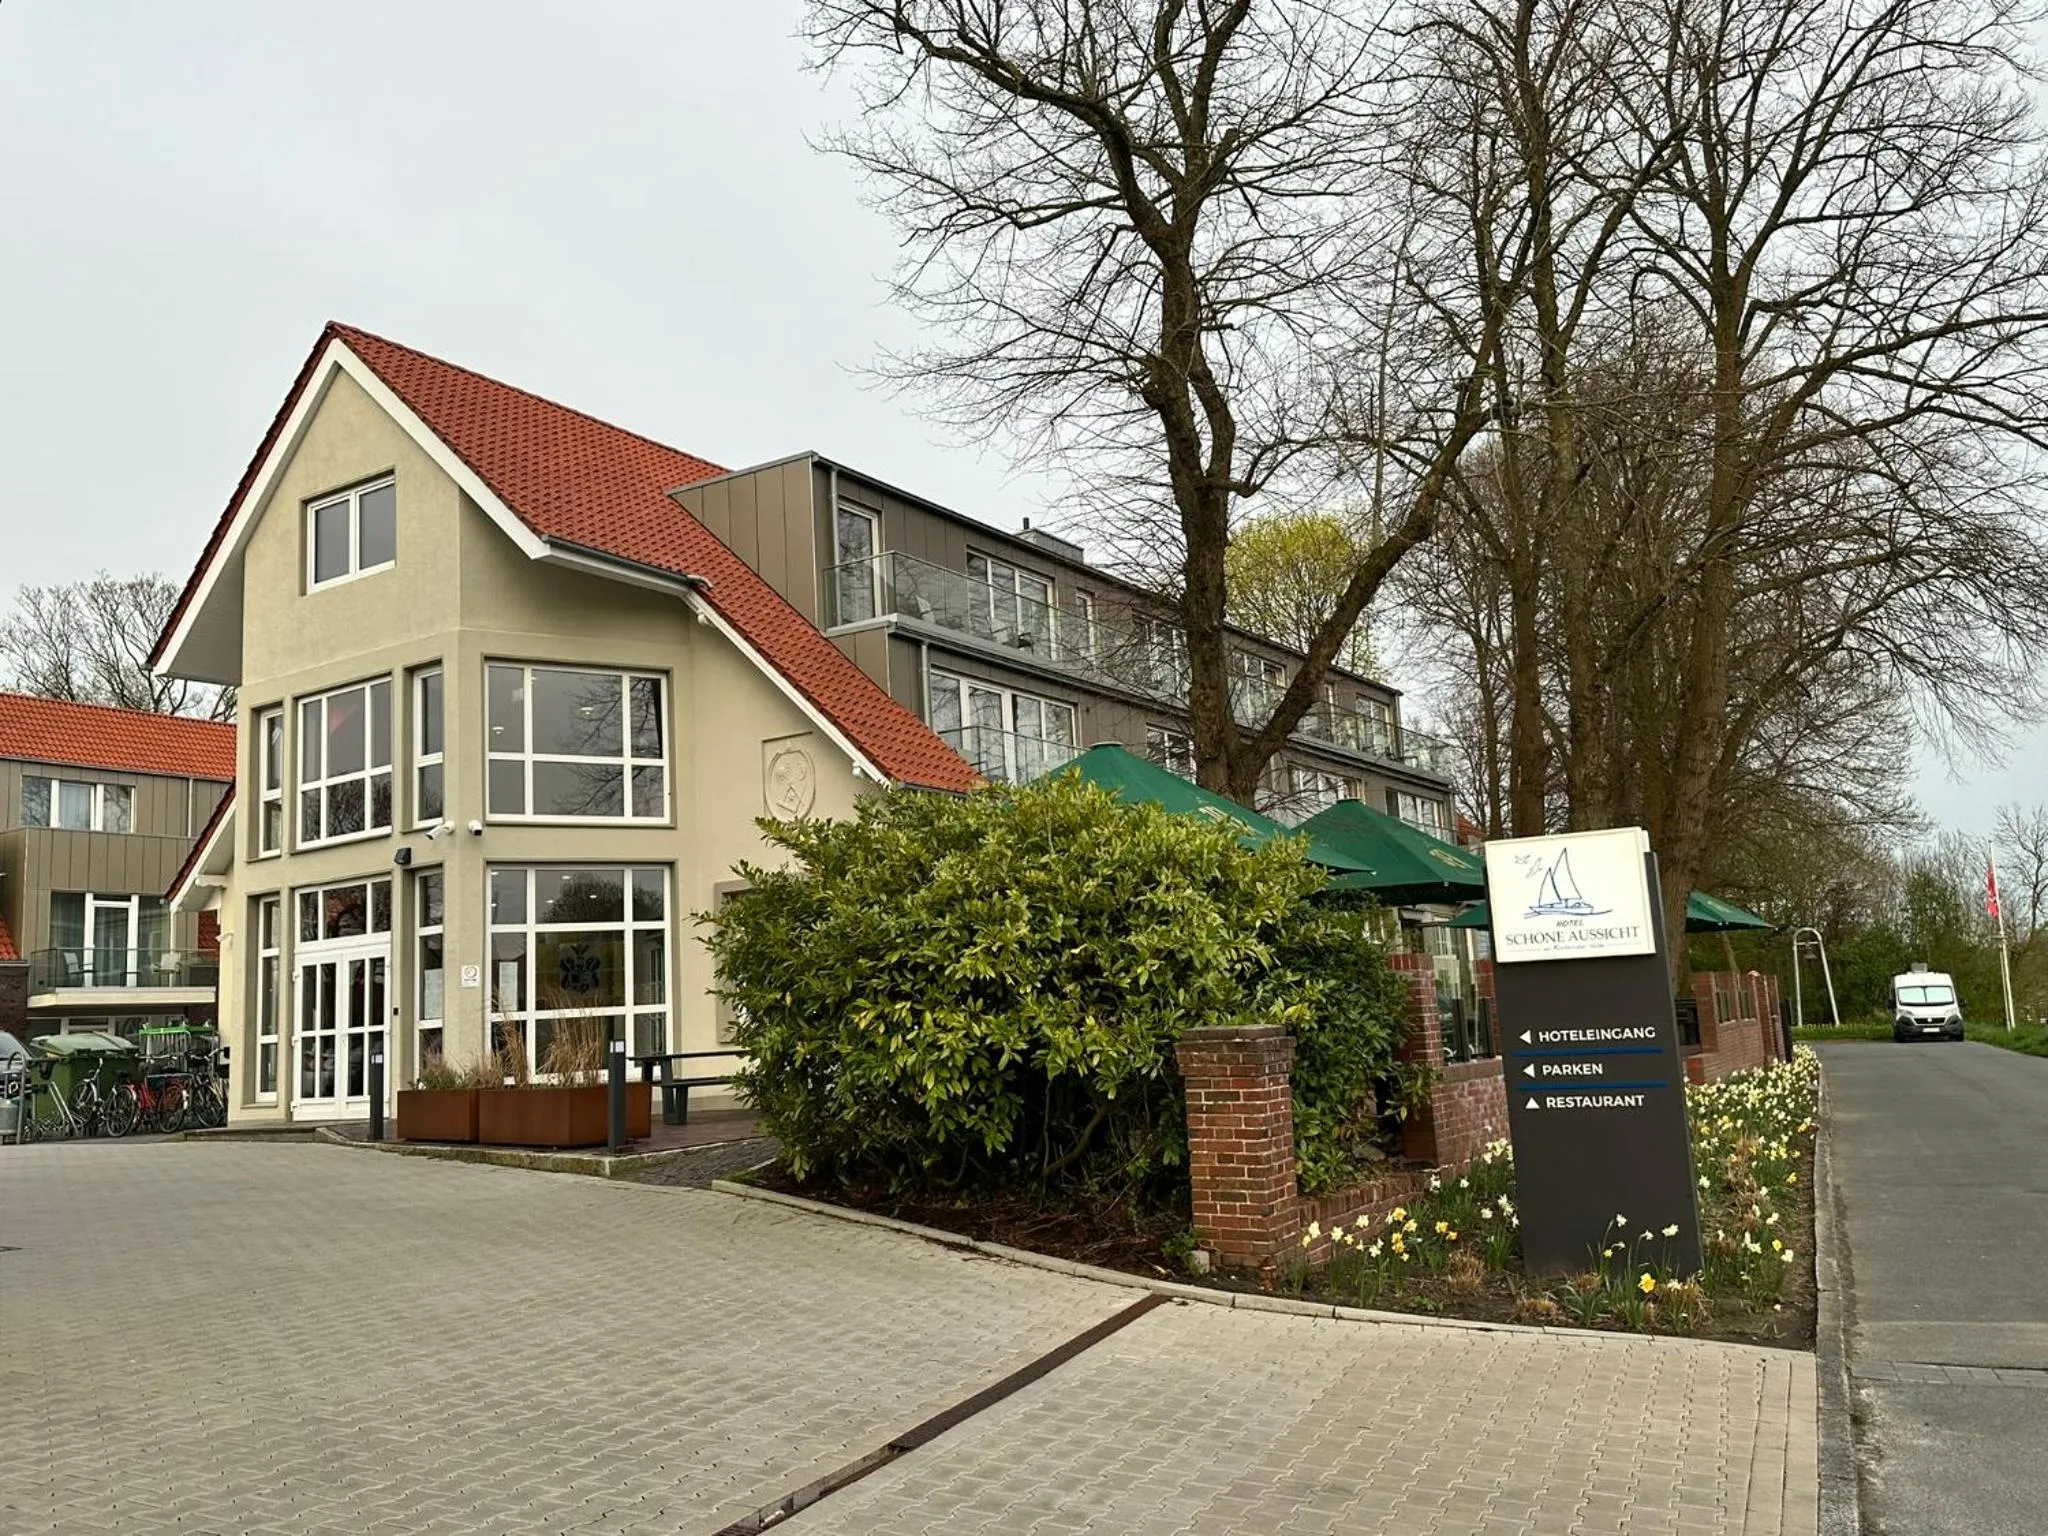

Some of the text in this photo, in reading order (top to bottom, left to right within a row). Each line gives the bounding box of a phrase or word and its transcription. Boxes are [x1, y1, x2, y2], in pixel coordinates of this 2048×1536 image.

[1556, 919, 1584, 927] HOTEL
[1568, 926, 1639, 942] AUSSICHT
[1539, 1026, 1656, 1042] HOTELEINGANG
[1542, 1063, 1603, 1076] PARKEN
[1546, 1095, 1644, 1108] RESTAURANT
